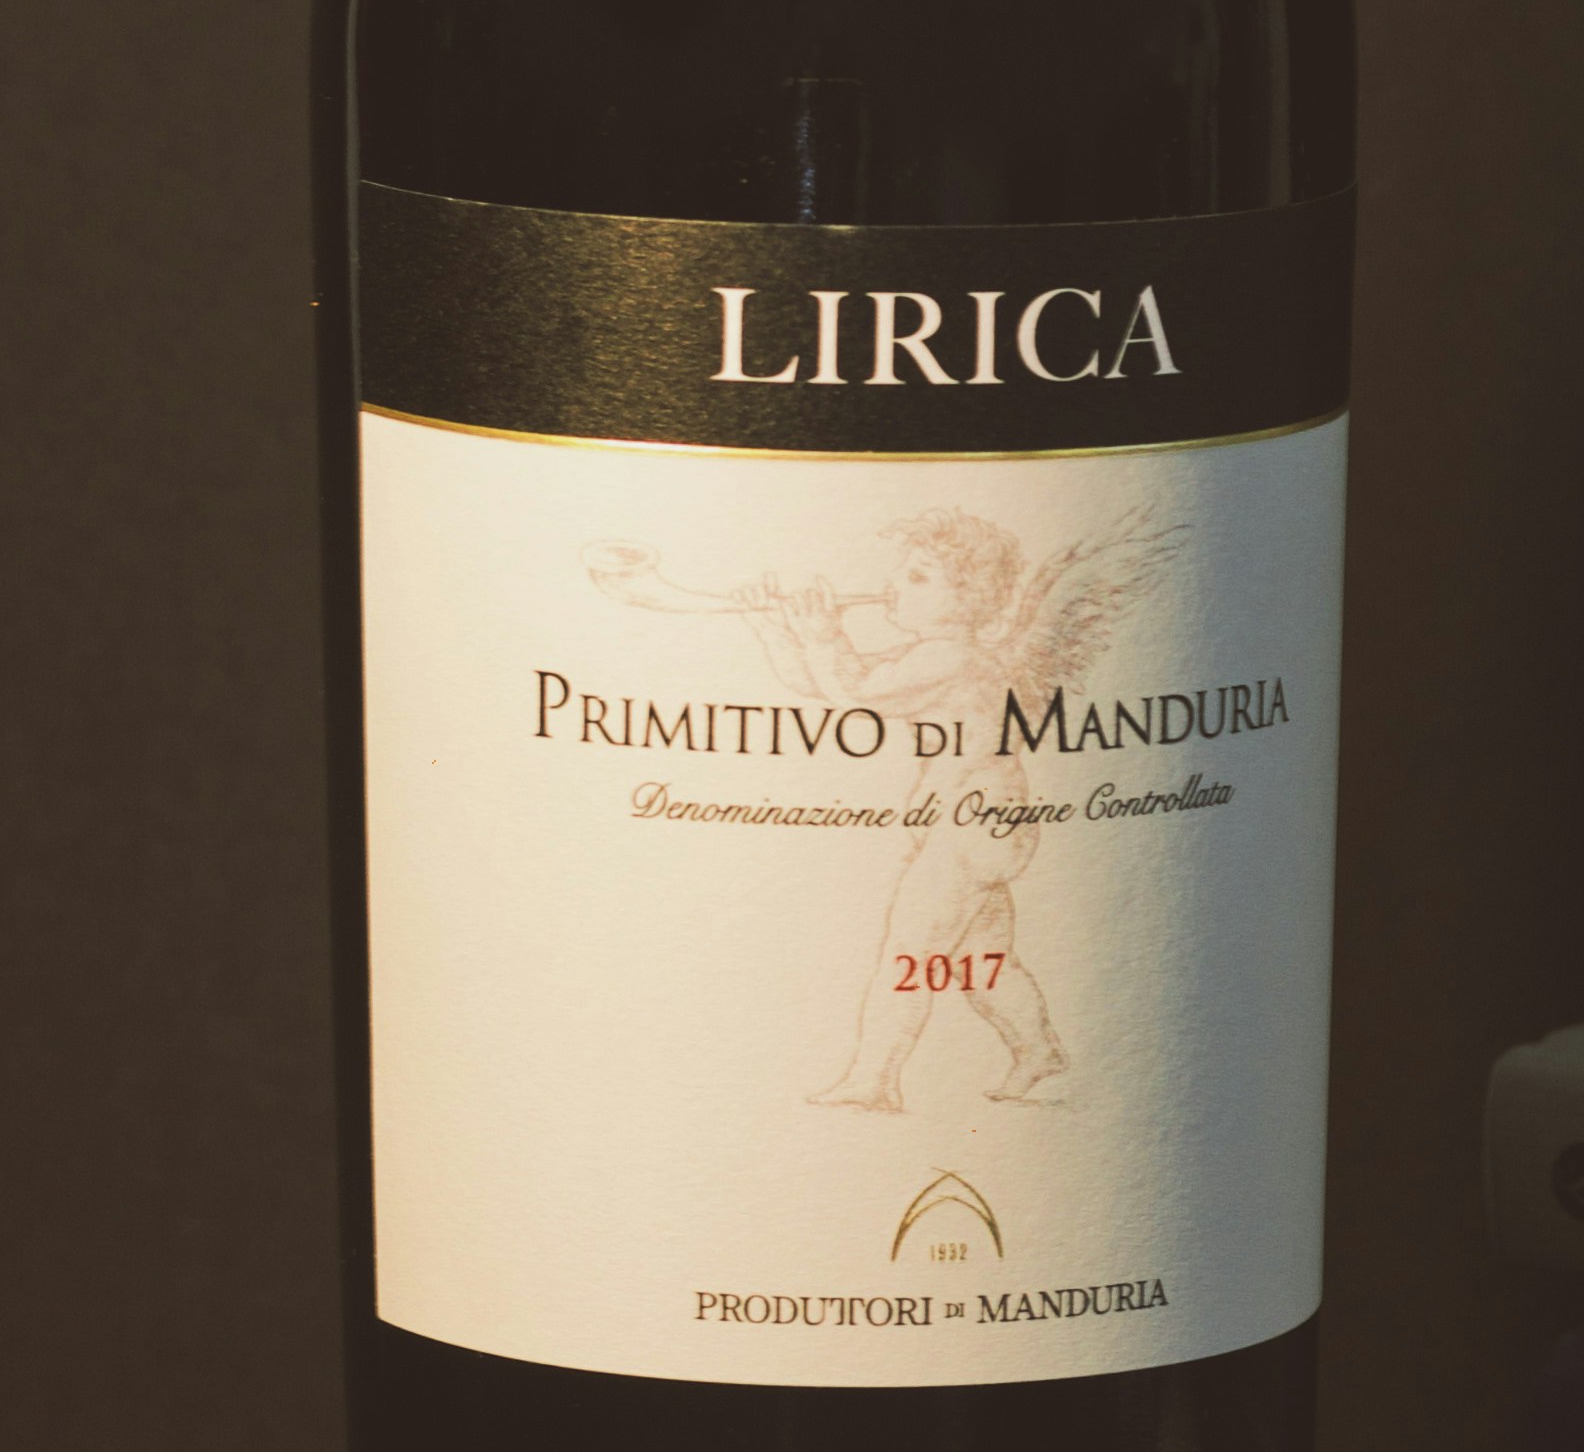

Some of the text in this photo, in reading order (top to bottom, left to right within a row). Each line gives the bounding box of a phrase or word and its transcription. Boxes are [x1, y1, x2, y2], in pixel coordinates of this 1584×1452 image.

[710, 284, 1183, 385] LIRICA
[533, 669, 1290, 759] PRIMITIVO DI MANDURIA
[631, 772, 1237, 840] Denominazione di Origine Controllata
[893, 951, 1007, 993] 2017
[929, 1242, 968, 1262] 1932
[694, 1277, 1170, 1326] PRODUTTORI DI MANDURIA
